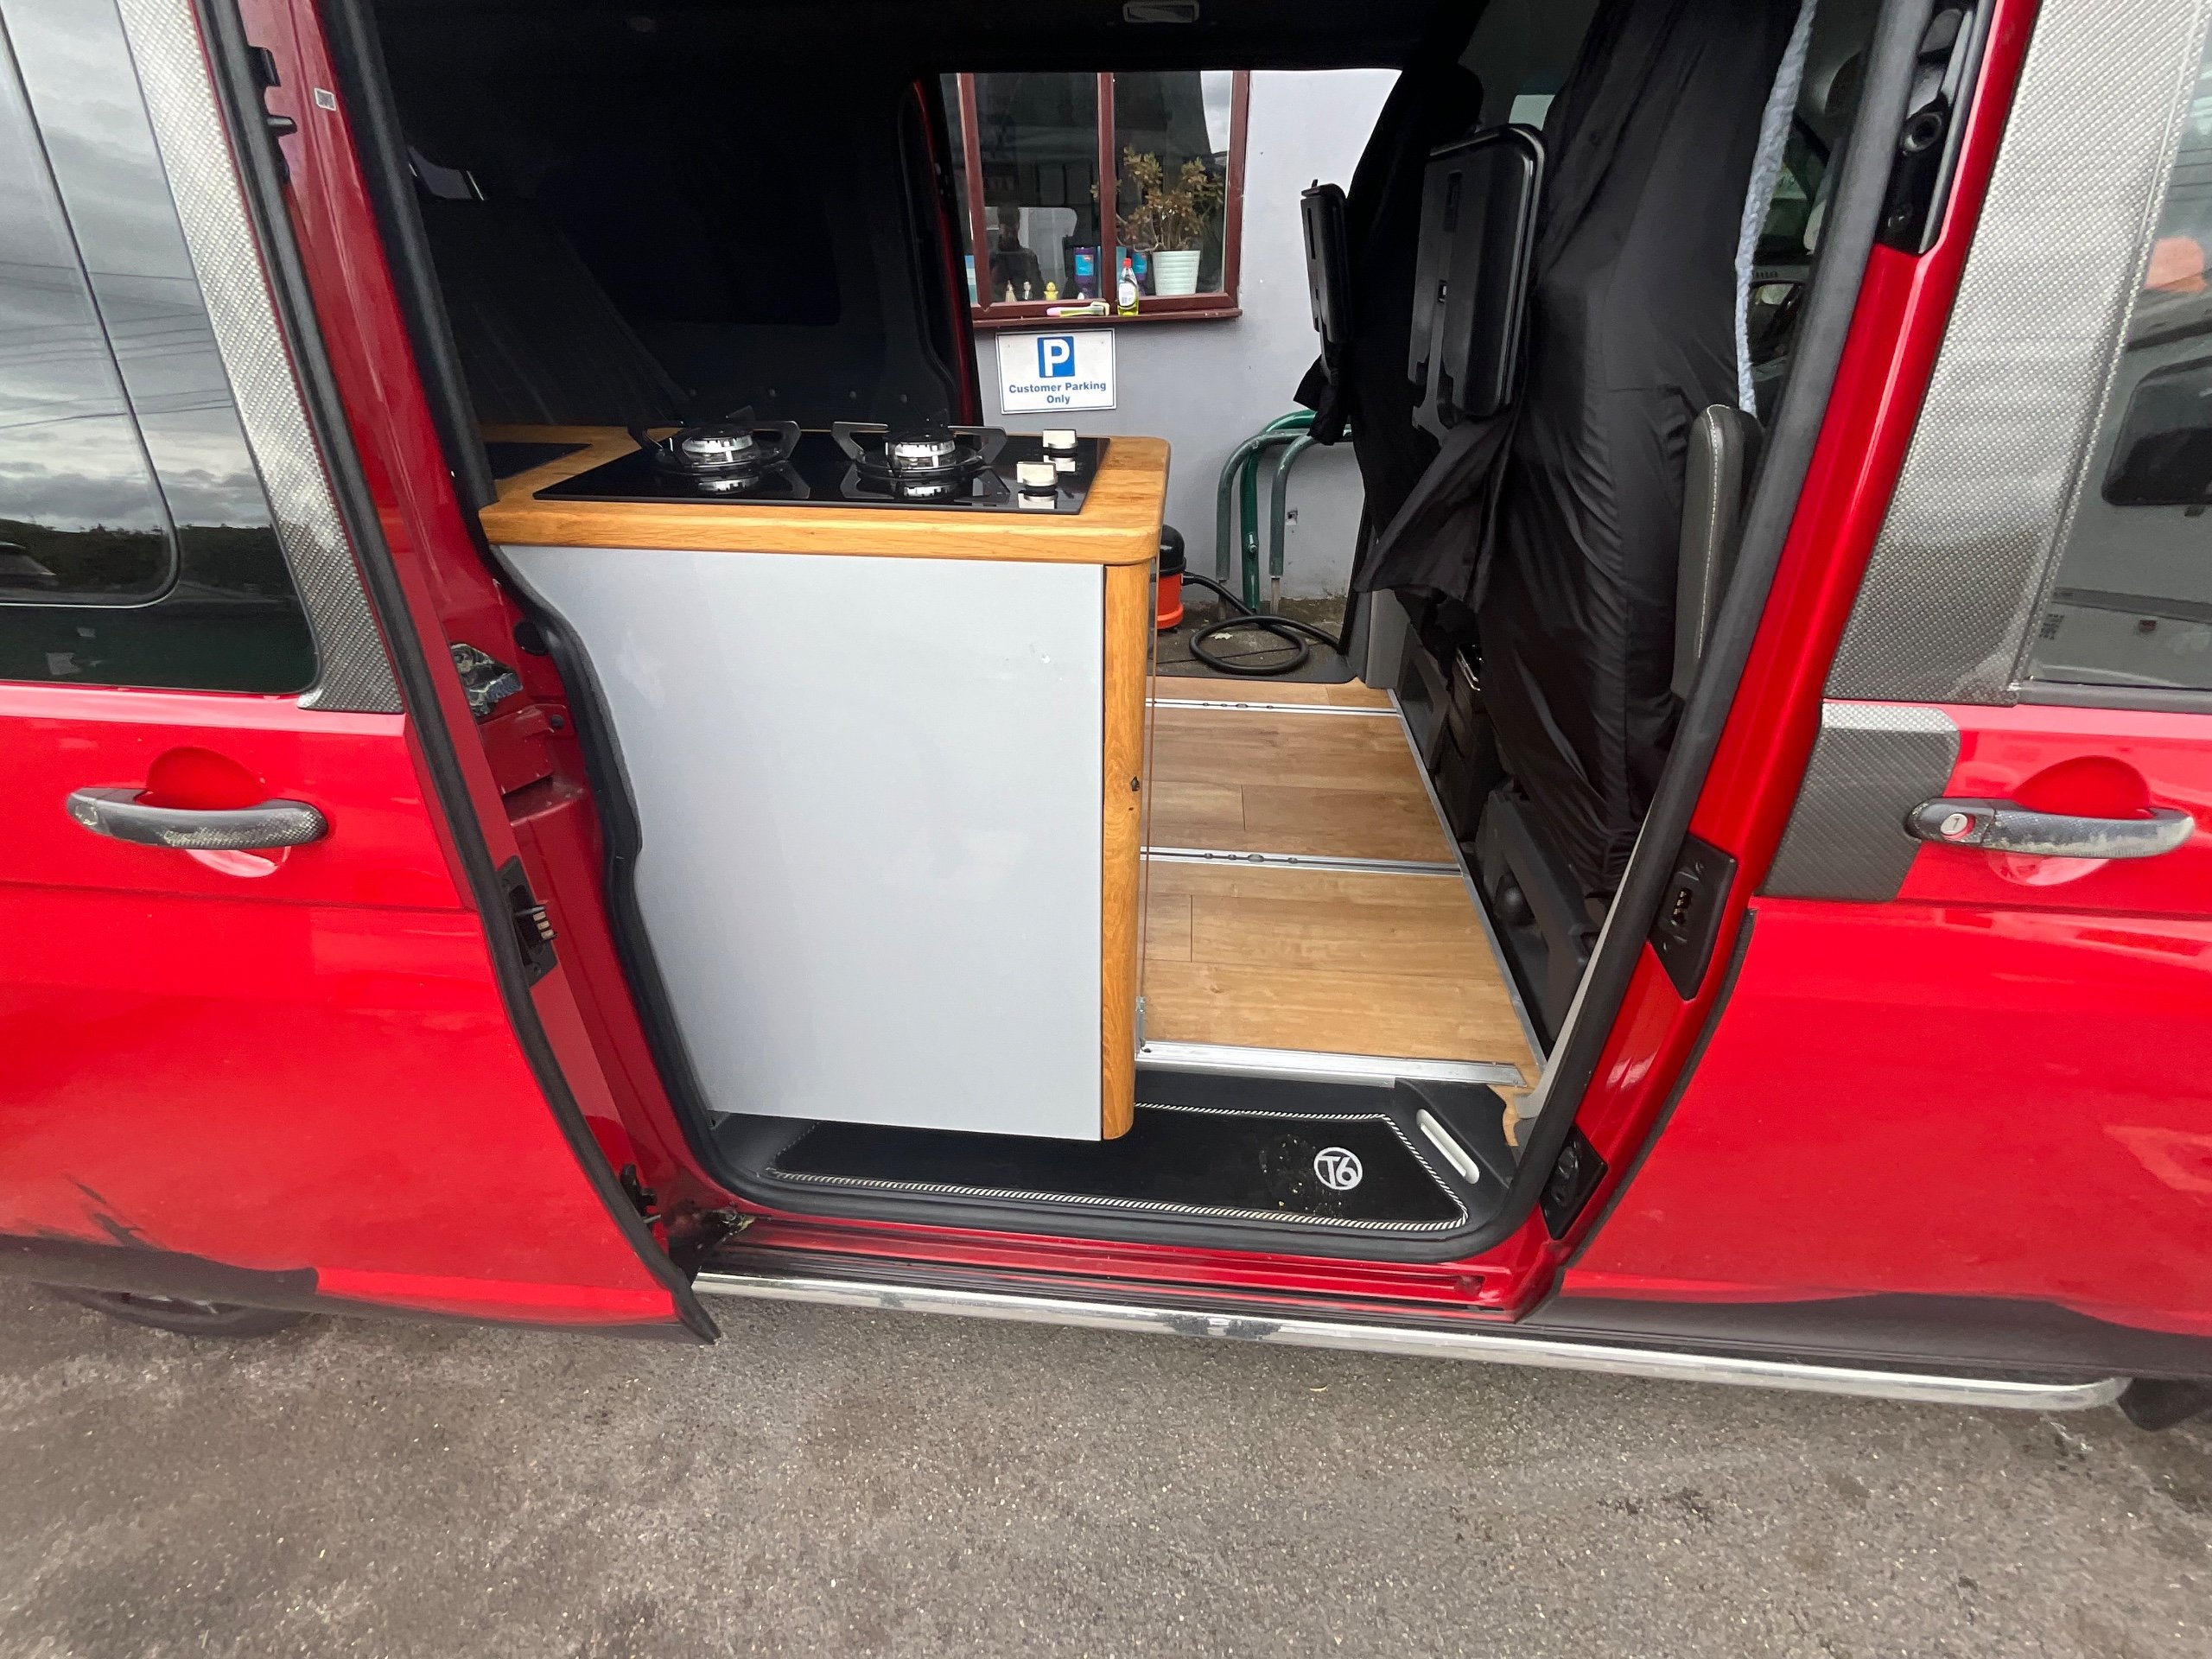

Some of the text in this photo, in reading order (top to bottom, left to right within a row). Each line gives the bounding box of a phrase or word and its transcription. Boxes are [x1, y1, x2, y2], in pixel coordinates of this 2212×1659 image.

[1043, 338, 1071, 377] P
[1009, 381, 1107, 393] Customer Parking
[1046, 394, 1071, 404] Only
[1318, 1154, 1359, 1189] T6
